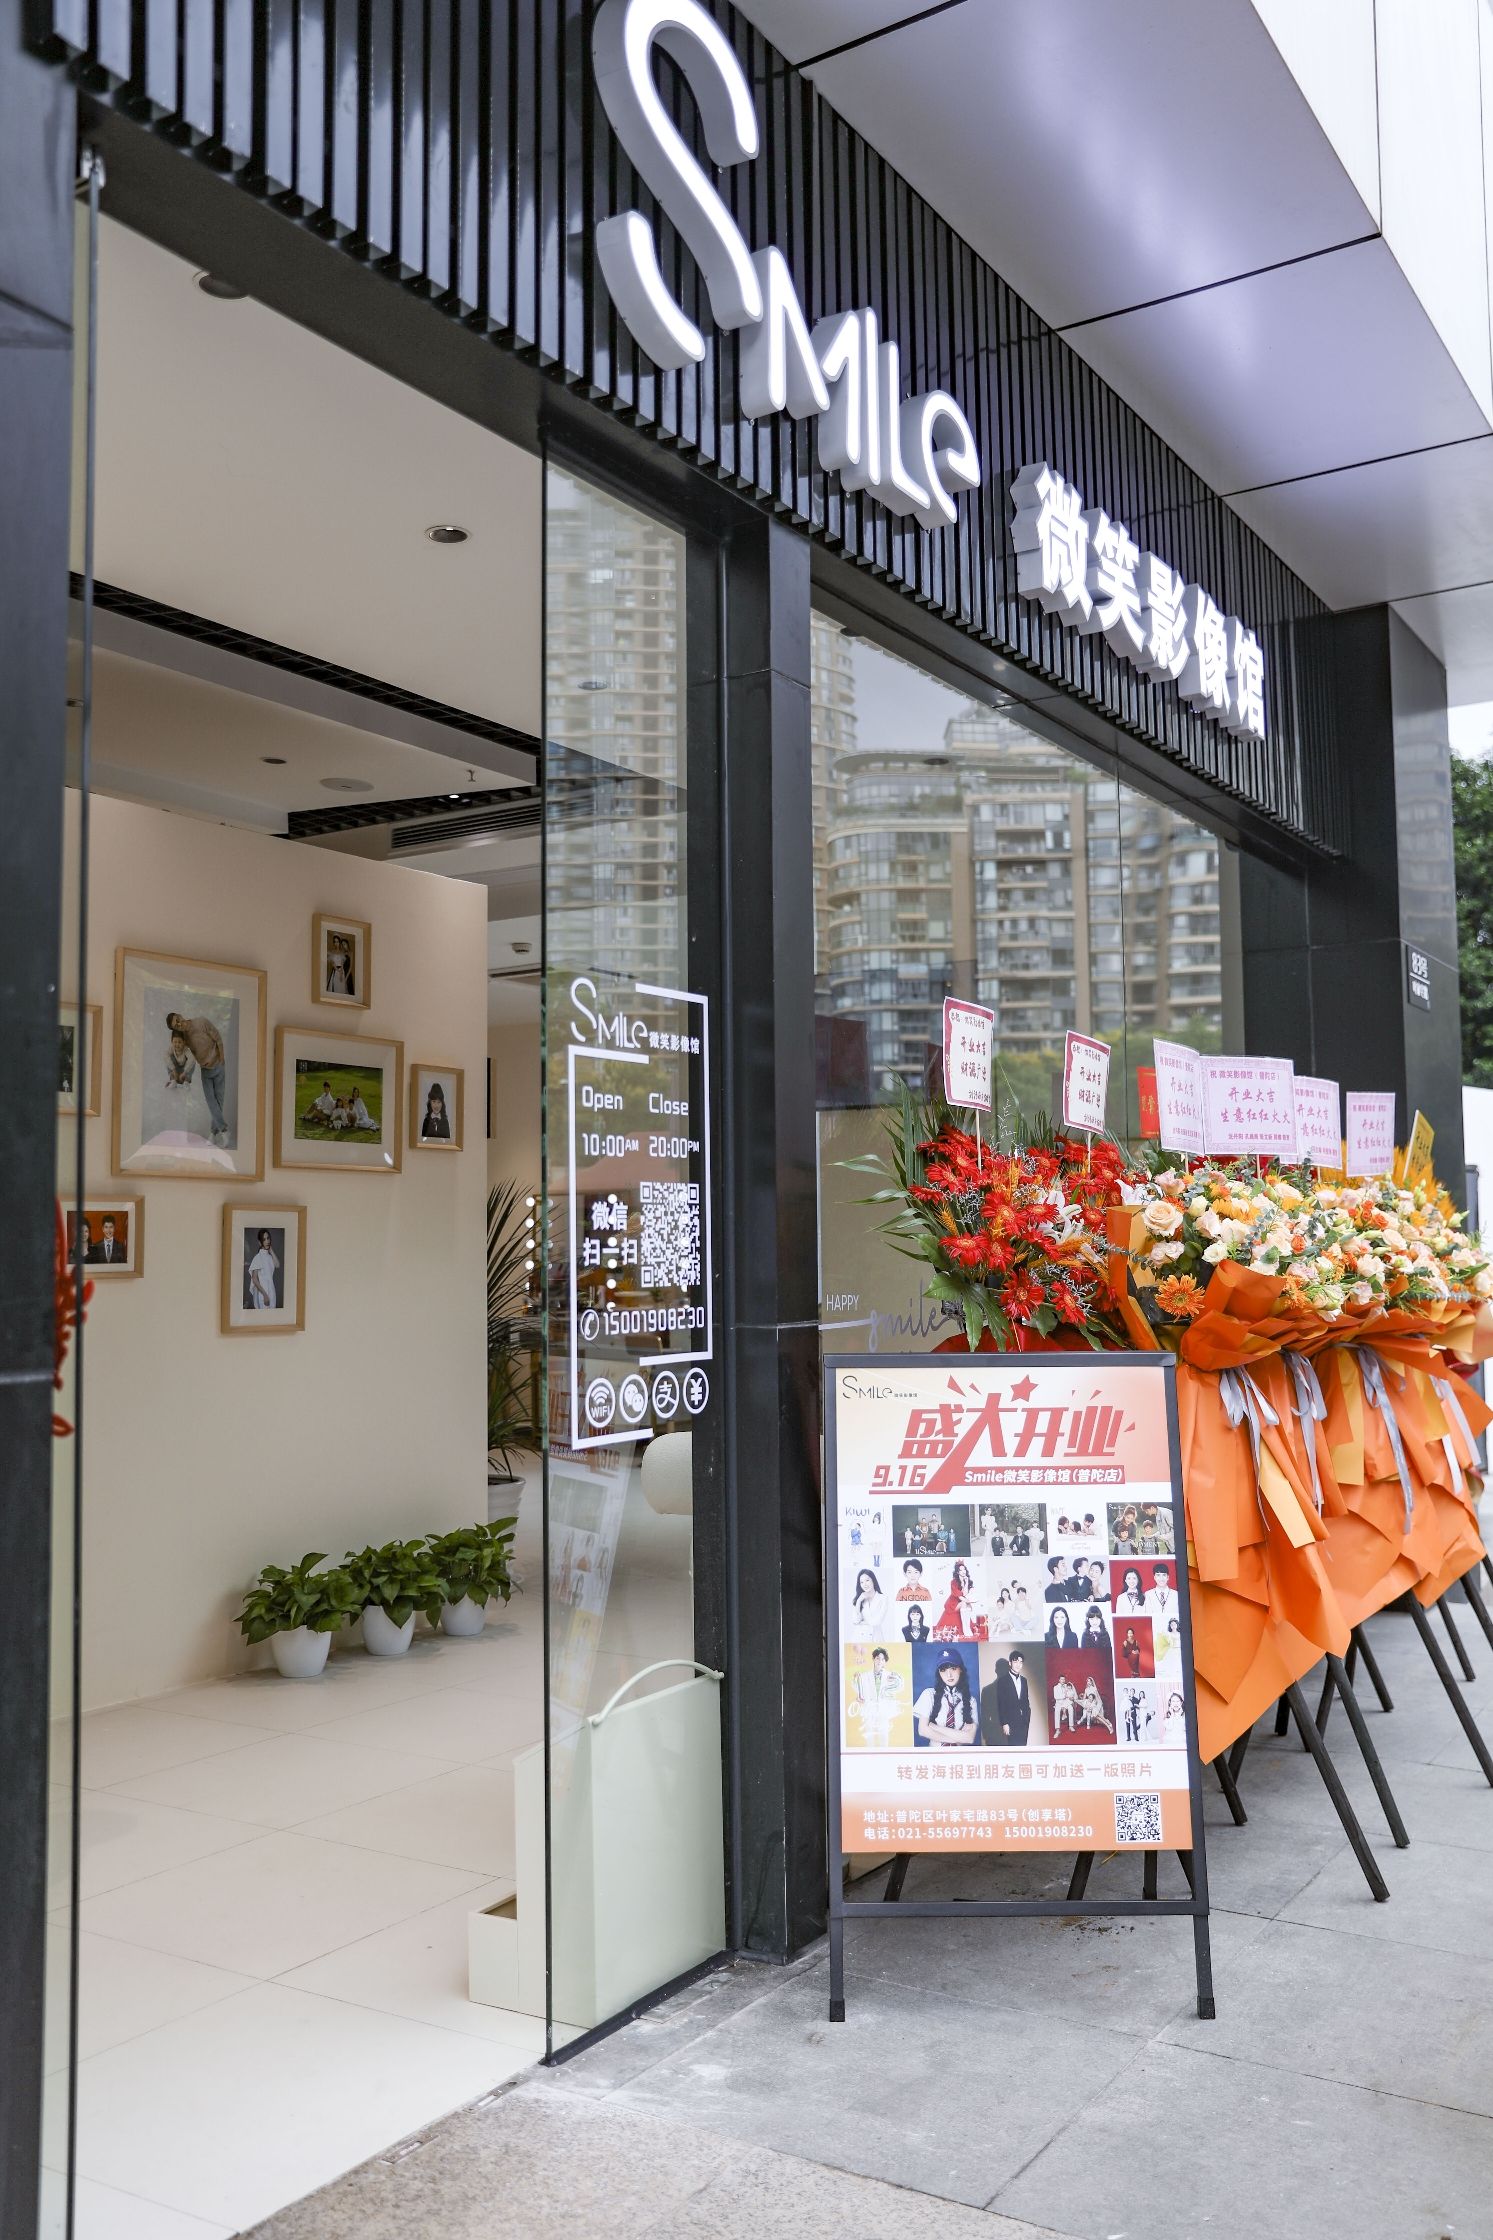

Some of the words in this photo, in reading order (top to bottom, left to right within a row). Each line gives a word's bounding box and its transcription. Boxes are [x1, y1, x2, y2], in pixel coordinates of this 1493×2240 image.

[1010, 461, 1265, 742] 微笑影像馆
[649, 1031, 700, 1055] 微笑影像馆
[581, 1085, 623, 1112] Open
[649, 1092, 689, 1116] Close
[1228, 1086, 1276, 1103] 开业大吉
[591, 1201, 629, 1231] 微信
[583, 1237, 638, 1267] 扫一扫
[826, 1294, 860, 1311] HAPPY
[603, 1306, 705, 1336] 15001908230
[898, 1392, 1125, 1460] 盛大开业
[871, 1464, 927, 1488] 9.16
[896, 1762, 1153, 1780] 转发海报到朋友圈可加送一版照片
[1004, 1825, 1093, 1839] 15001908230
